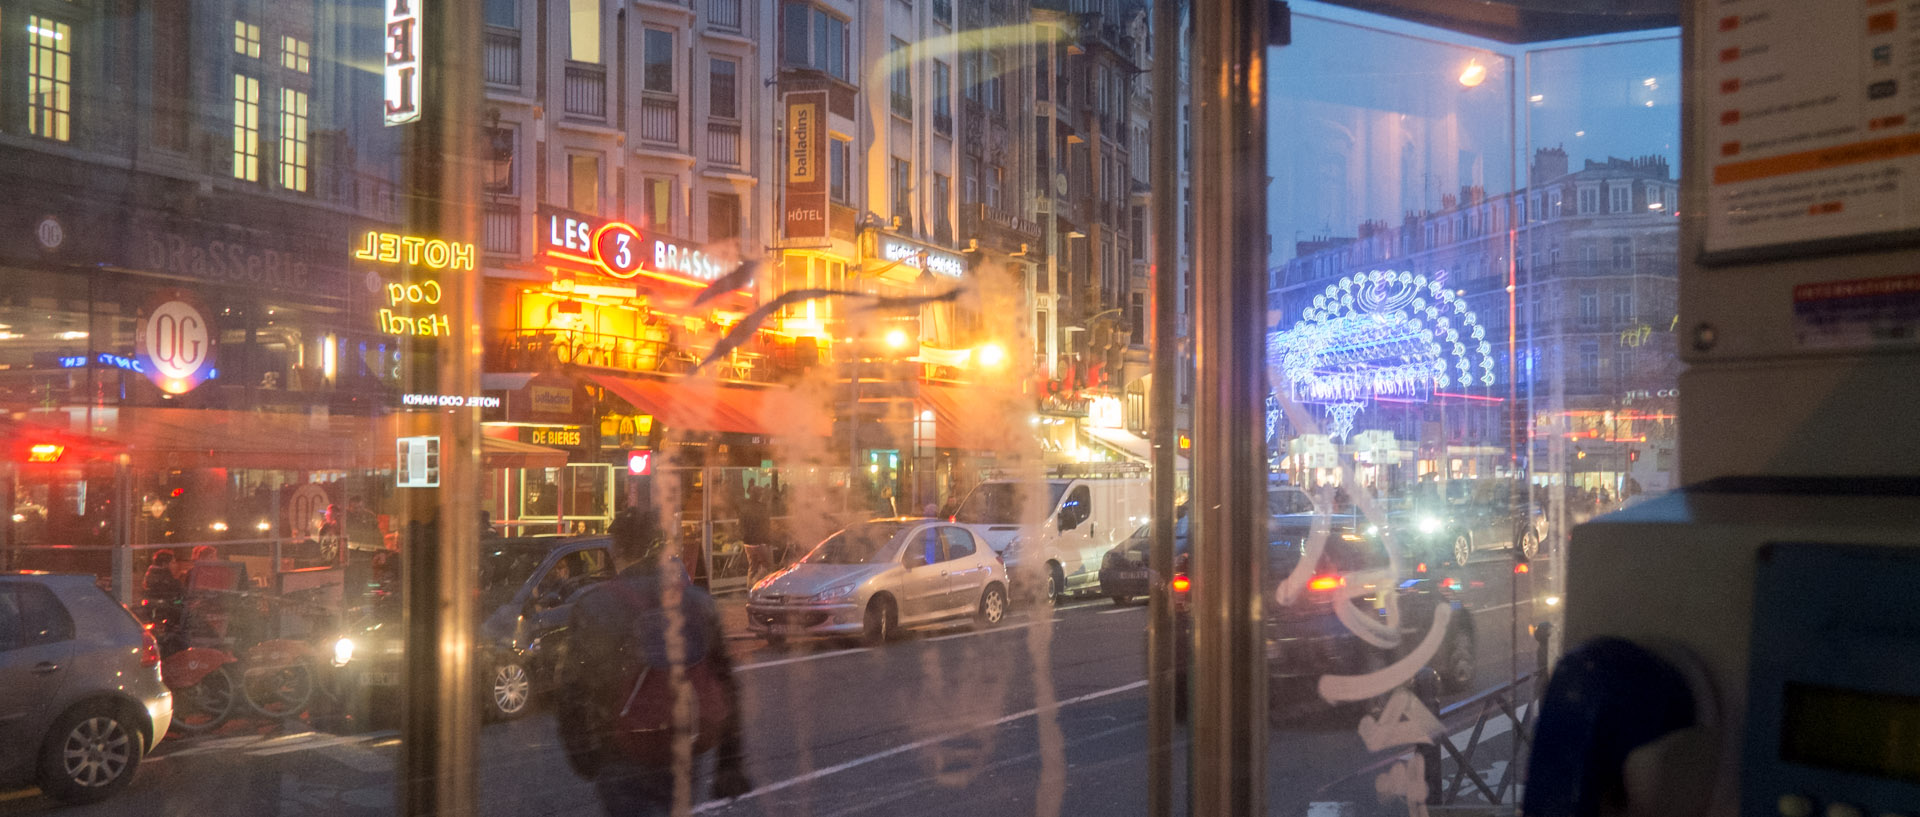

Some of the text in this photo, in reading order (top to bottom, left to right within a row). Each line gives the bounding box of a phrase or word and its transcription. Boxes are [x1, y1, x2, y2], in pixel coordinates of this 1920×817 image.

[794, 107, 808, 178] balladins
[787, 207, 824, 222] HÔTEL
[550, 215, 591, 252] LES
[614, 233, 632, 269] 3
[155, 313, 200, 370] QG
[532, 430, 546, 444] DE
